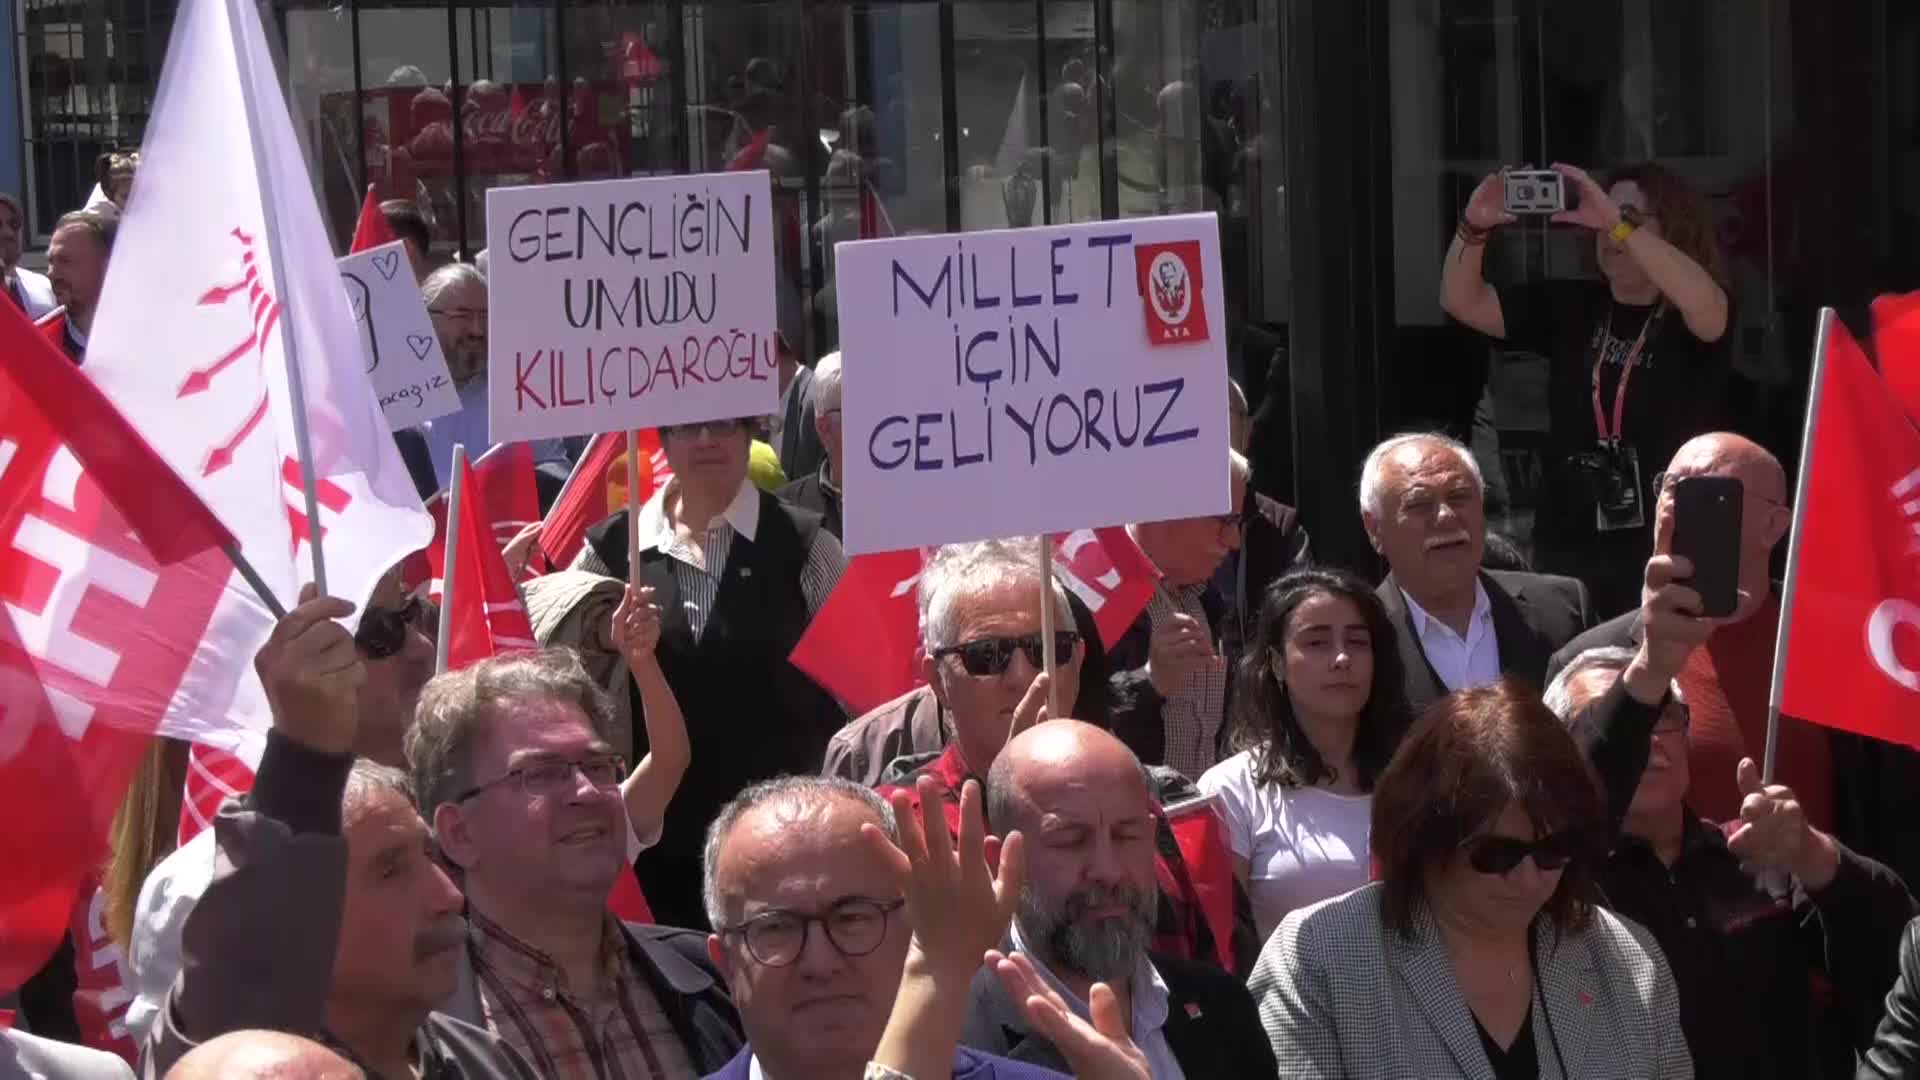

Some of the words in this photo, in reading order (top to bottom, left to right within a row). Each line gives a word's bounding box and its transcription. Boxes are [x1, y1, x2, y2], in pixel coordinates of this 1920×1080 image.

[508, 188, 751, 264] GENÇLİĞİN
[564, 271, 717, 330] UMUDU
[891, 233, 1133, 318] MİLLET
[515, 328, 780, 411] KILIÇDAROĞLU
[953, 315, 1062, 395] İÇİN
[868, 377, 1200, 470] GELİYORUZ
